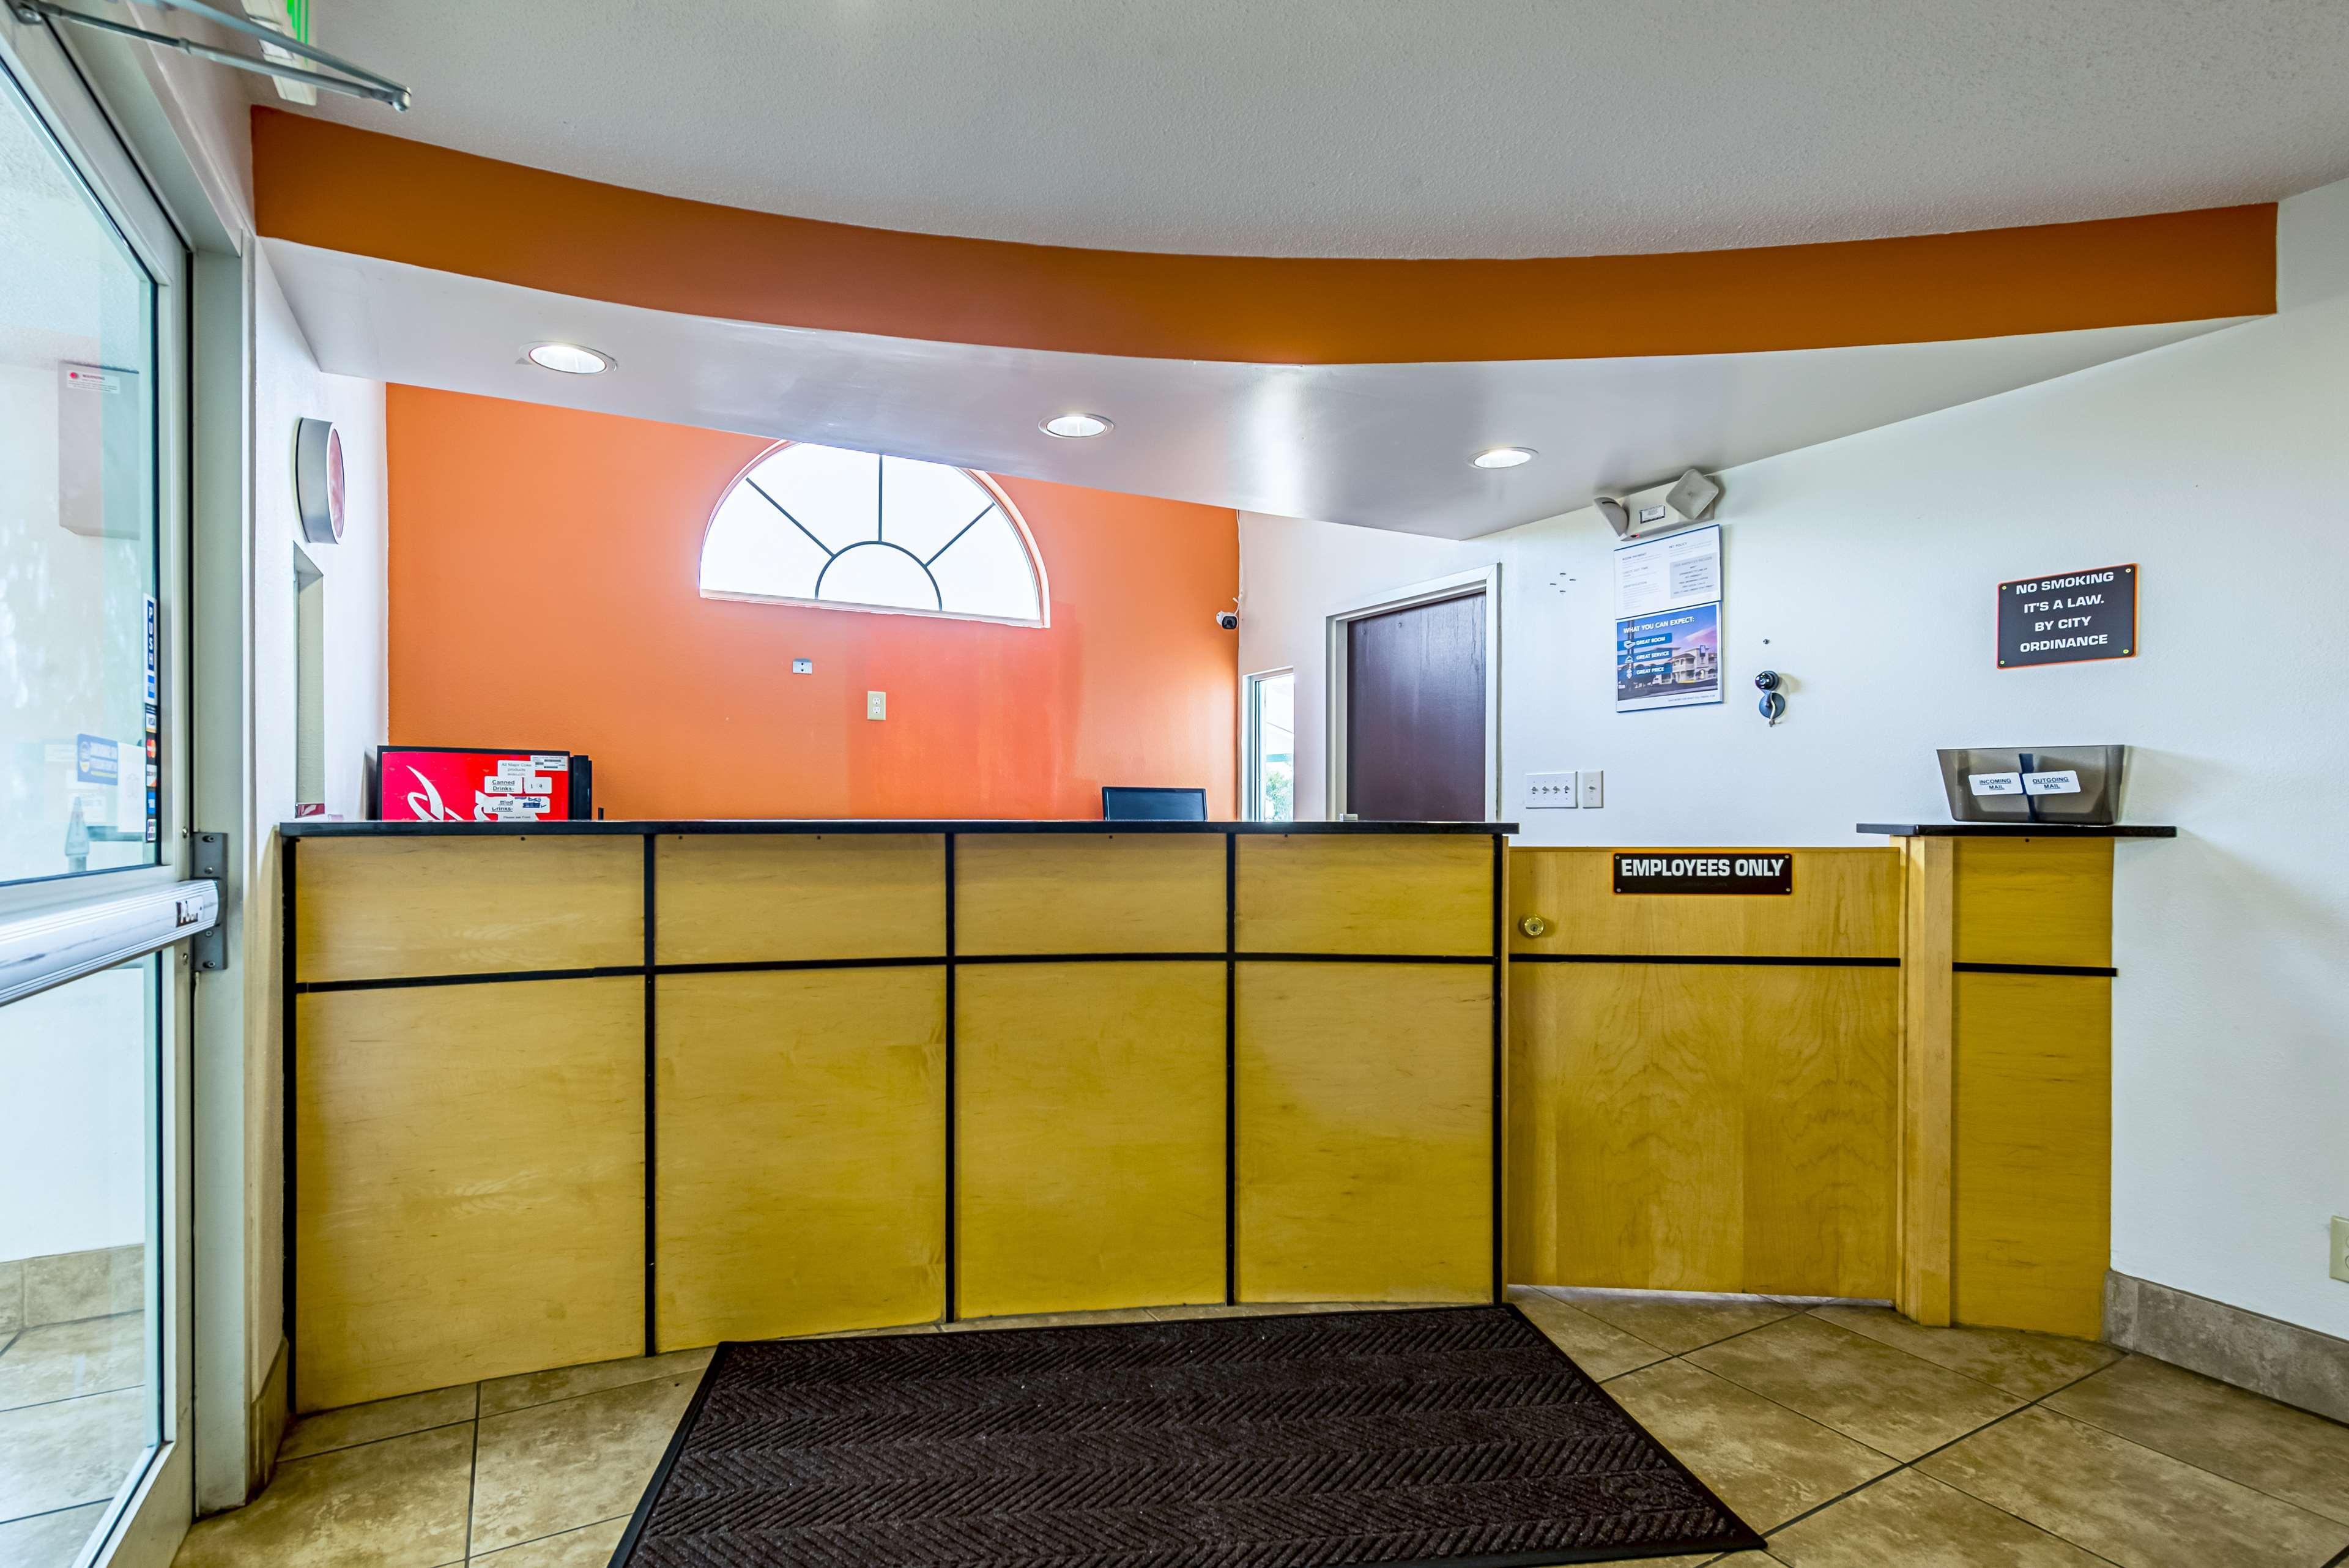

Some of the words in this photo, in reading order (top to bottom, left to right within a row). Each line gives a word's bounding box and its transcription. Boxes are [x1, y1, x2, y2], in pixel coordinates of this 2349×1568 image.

[2016, 583, 2038, 595] NO
[2041, 571, 2114, 590] SMOKING
[2024, 601, 2049, 614] IT'S
[2053, 600, 2063, 609] A
[2067, 594, 2104, 608] LAW.
[1624, 625, 1641, 634] WHAT
[1670, 616, 1694, 626] EXPECT:
[2035, 620, 2054, 632] BY
[2058, 616, 2091, 629] CITY
[2020, 634, 2108, 652] ORDINANCE
[1621, 859, 1731, 877] EMPLOYEES
[1735, 859, 1784, 877] ONLY
